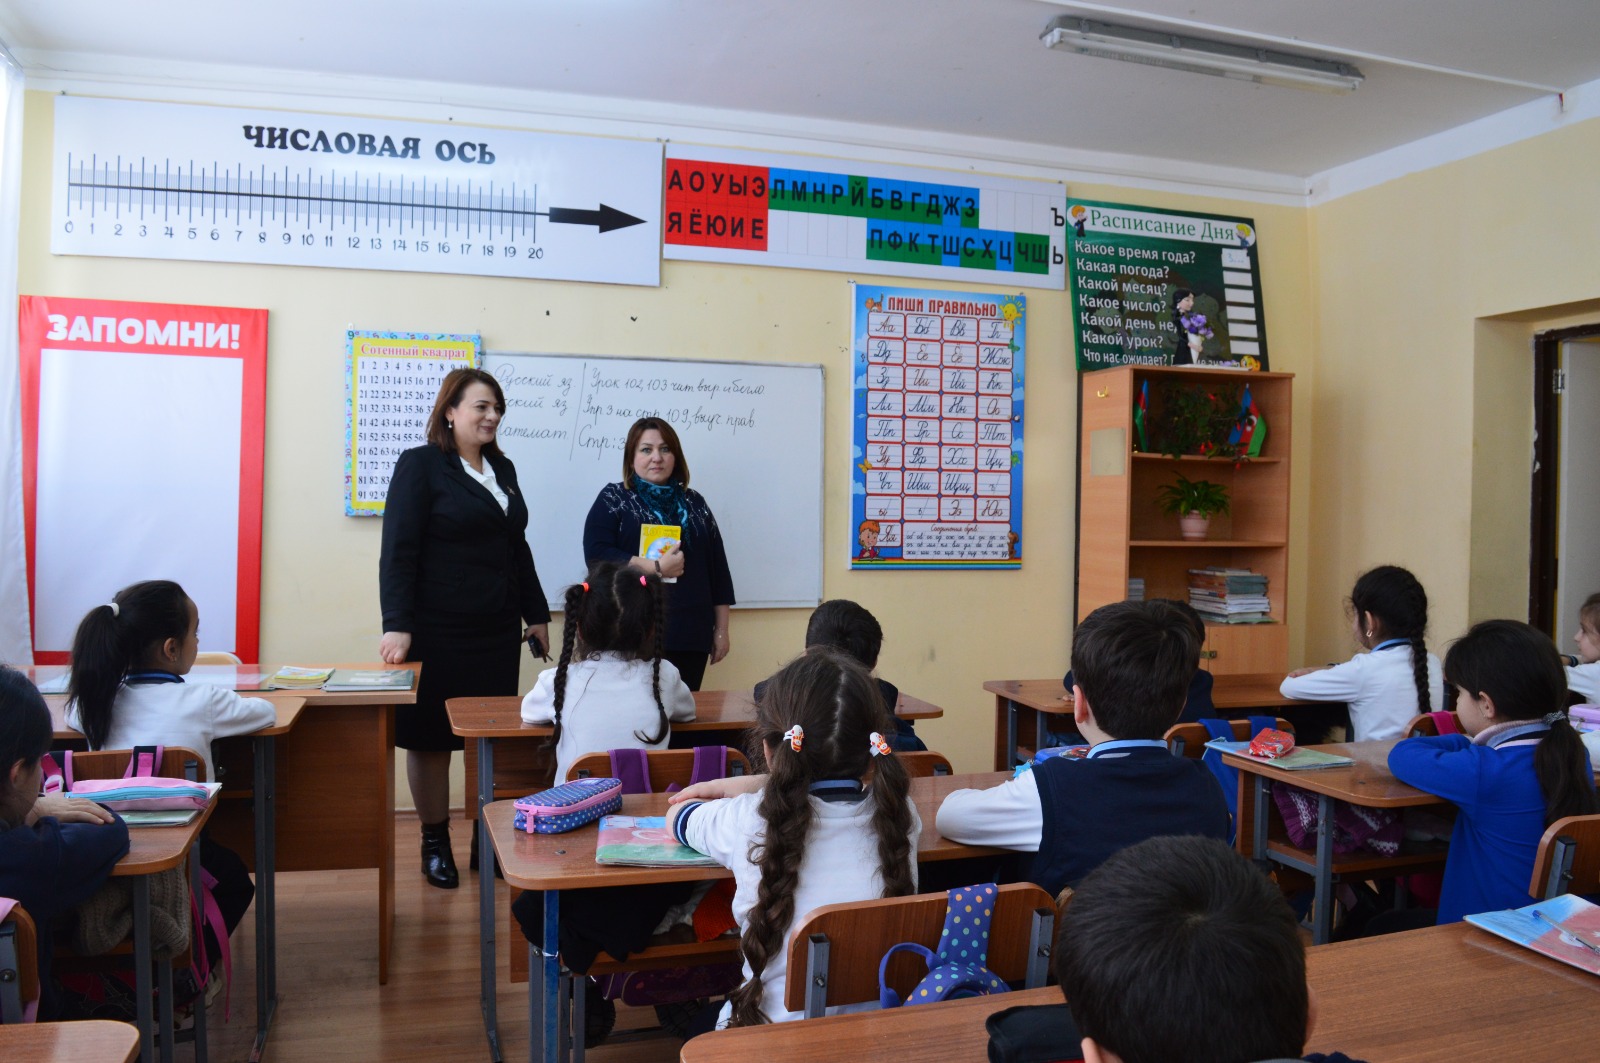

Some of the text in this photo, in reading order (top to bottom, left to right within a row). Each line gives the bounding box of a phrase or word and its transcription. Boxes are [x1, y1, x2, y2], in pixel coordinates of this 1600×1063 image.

[242, 125, 496, 164] ЧИСЛОВАЯ ОСЬ
[1091, 209, 1235, 241] Расписание Дня
[65, 221, 543, 259] 0 1 2 3 4 5 6 7 8 9 10 11 12 13 14 15 16 17 18 19 20
[1075, 240, 1195, 264] Какое время года?
[1077, 258, 1169, 278] Какая погода?
[1078, 276, 1167, 296] Какой месяц?
[888, 297, 997, 317] ПИШИ ПРАВИЛЬНО
[1080, 294, 1166, 313] Какое число?
[46, 314, 240, 350] ЗАПОМНИ!
[1081, 312, 1121, 328] Какой
[1125, 318, 1155, 331] день
[1083, 330, 1163, 349] Какой урок?
[361, 343, 467, 359] Сотенный квадрат
[1084, 348, 1100, 362] Что
[1103, 352, 1119, 363] нас
[1123, 353, 1167, 366] ожидает?
[495, 363, 553, 391] Русский
[591, 368, 619, 394] Урок
[625, 379, 643, 392] 102,
[647, 378, 668, 391] 103
[616, 408, 632, 418] на
[666, 408, 691, 431] 109,
